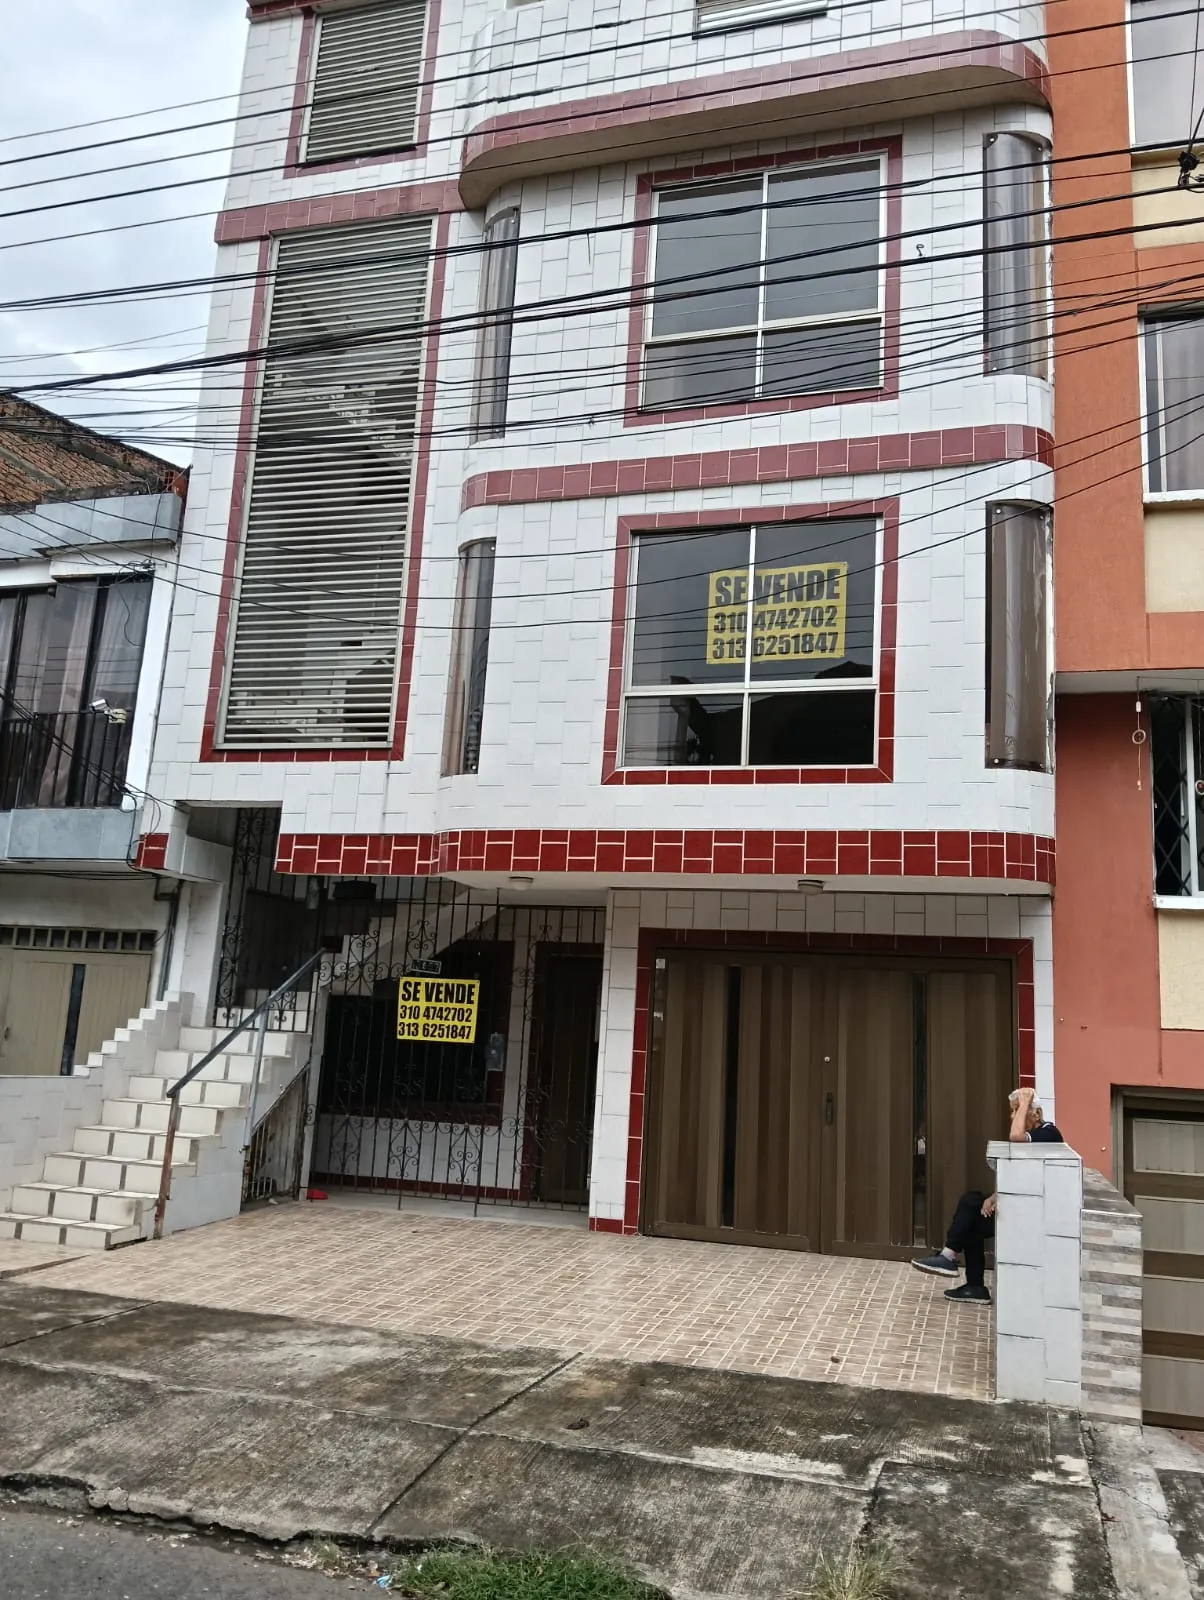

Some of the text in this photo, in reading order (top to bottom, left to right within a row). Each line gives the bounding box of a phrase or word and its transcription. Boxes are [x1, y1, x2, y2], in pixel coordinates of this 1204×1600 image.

[715, 569, 841, 606] SE VENDE
[714, 606, 838, 633] 310 4742702
[713, 632, 838, 659] 313 6251847
[402, 981, 475, 1004] SE VENDE
[400, 1005, 472, 1022] 310 4742702
[399, 1022, 471, 1039] 313 6251847
